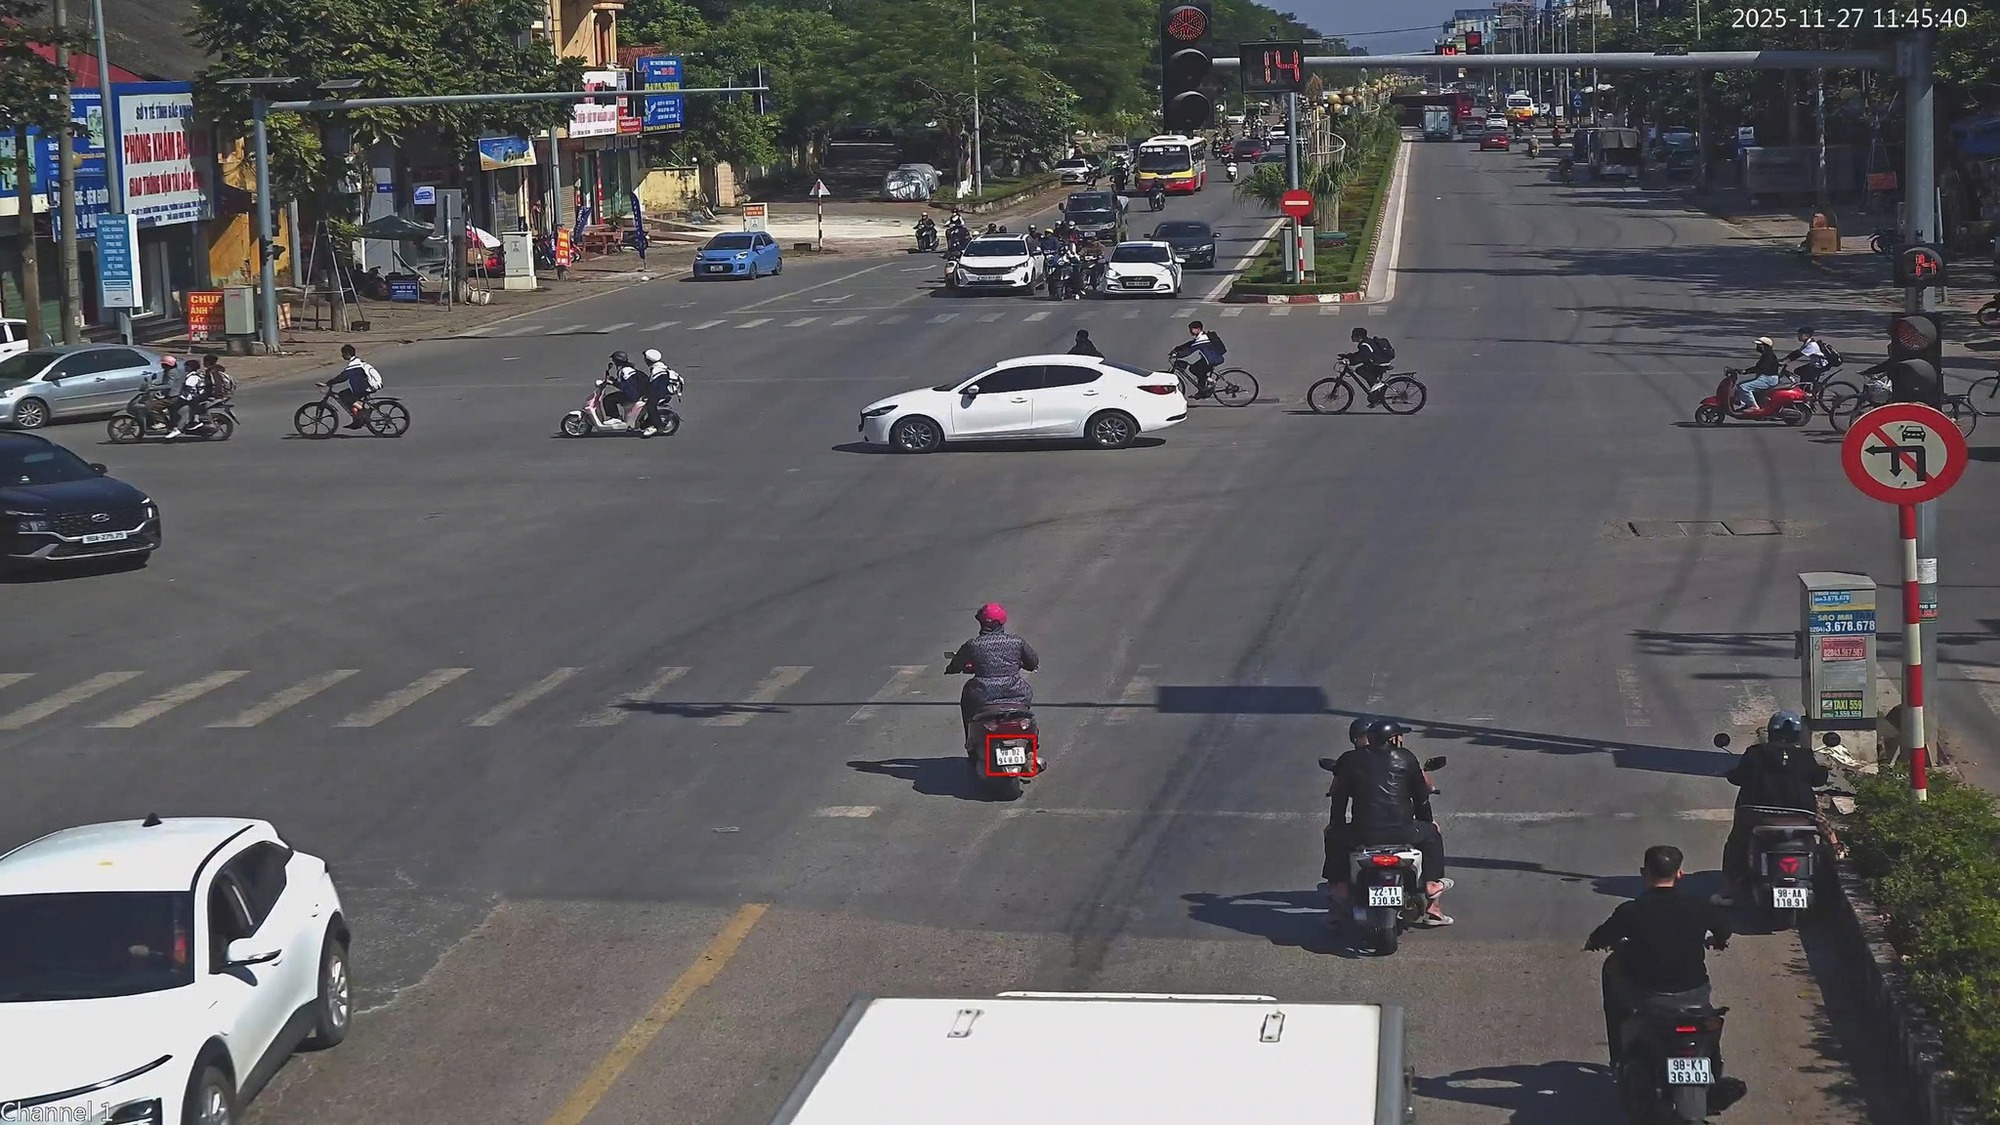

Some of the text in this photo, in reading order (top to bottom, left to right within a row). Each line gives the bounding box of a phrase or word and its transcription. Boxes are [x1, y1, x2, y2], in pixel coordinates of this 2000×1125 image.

[1264, 49, 1300, 83] 14
[123, 126, 152, 165] PHÒNG
[152, 125, 176, 162] KHÁM
[1825, 620, 1876, 632] 3.678.678
[1833, 700, 1862, 710] TAXI 559
[1777, 889, 1802, 898] 98-AA
[1775, 898, 1805, 907] 118.91
[1673, 1060, 1703, 1071] 98-K1
[1670, 1071, 1708, 1083] 363.03
